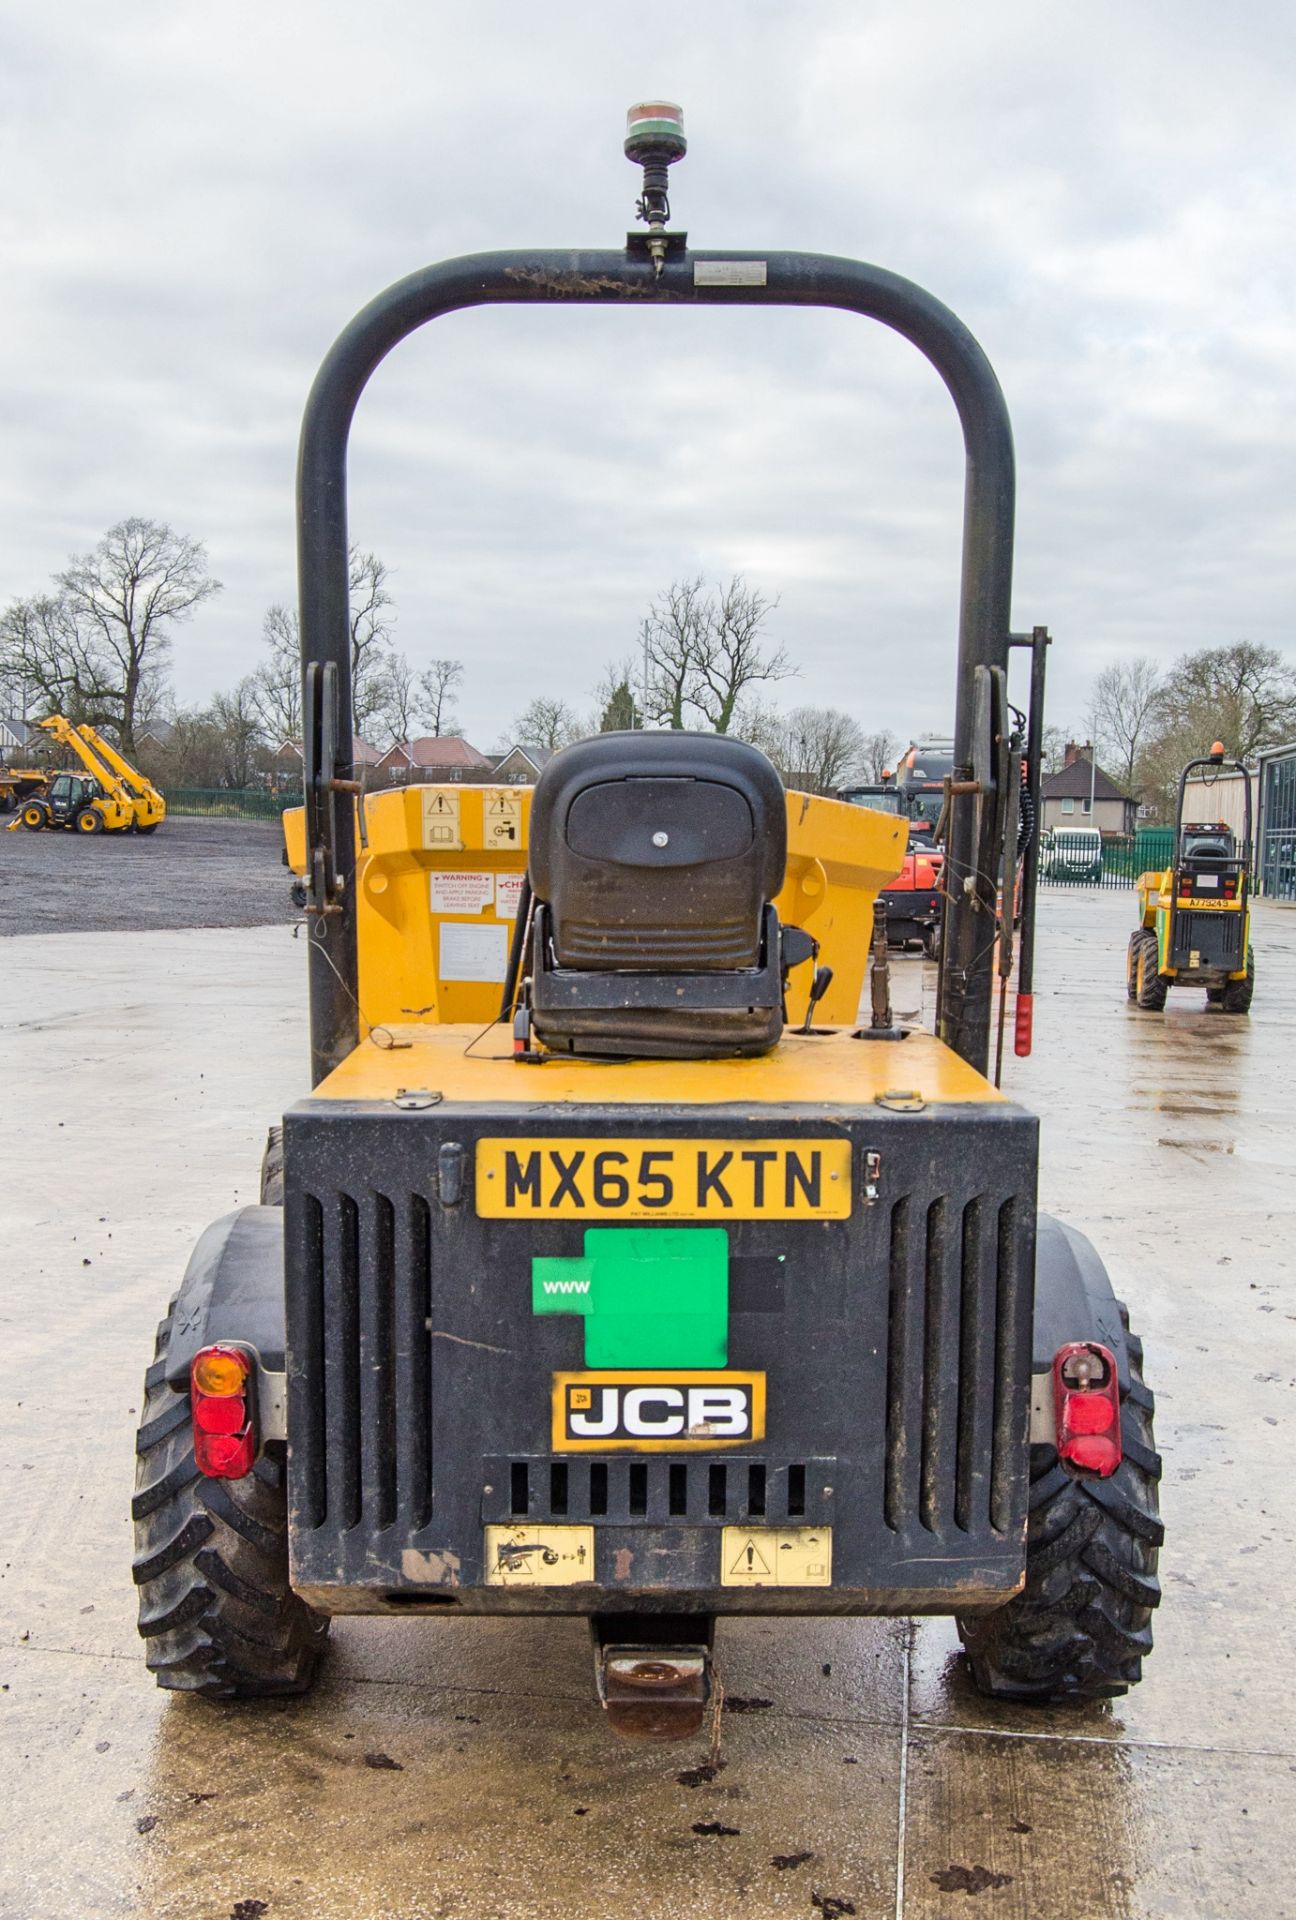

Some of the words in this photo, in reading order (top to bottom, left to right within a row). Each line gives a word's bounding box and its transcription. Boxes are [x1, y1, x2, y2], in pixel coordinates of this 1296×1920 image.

[505, 1150, 674, 1208] MX65
[696, 1150, 822, 1208] KTN
[570, 1388, 749, 1436] JCB
